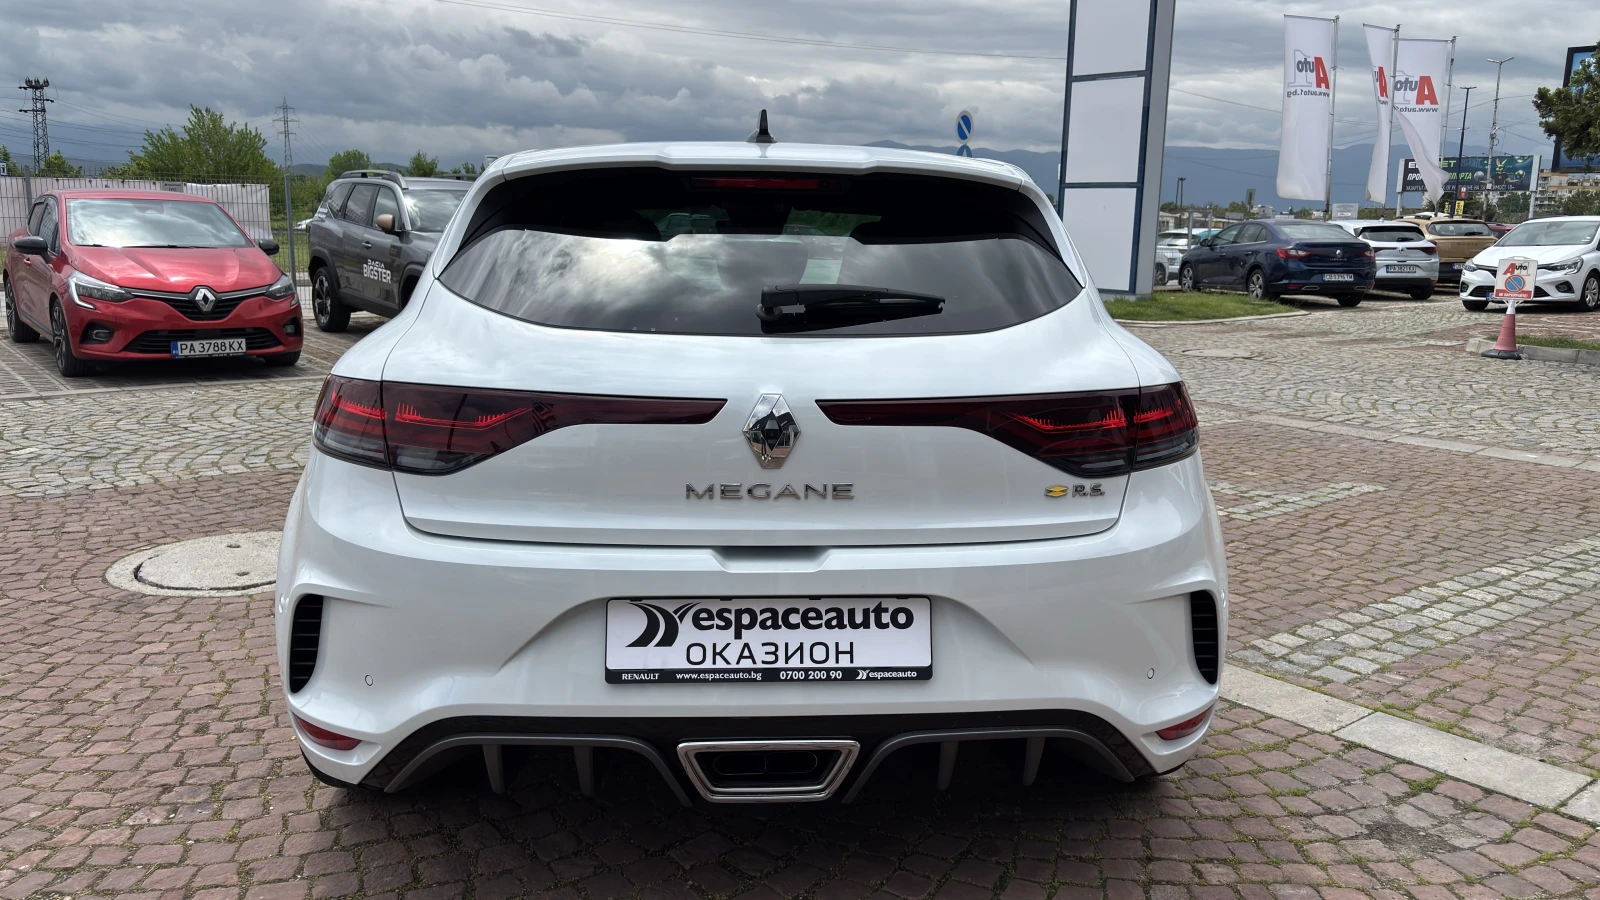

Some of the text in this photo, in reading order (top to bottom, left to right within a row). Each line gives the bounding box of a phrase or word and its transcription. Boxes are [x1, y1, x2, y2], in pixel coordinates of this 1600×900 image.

[363, 263, 392, 284] BIGSTER
[198, 342, 227, 353] 3788
[685, 482, 855, 500] MEGANE
[691, 601, 915, 640] espaceauto
[686, 642, 854, 665] ОКАЗИОН
[675, 671, 763, 681] www.espaceauto.bg
[779, 671, 805, 680] 0700
[807, 671, 827, 680] 200
[829, 671, 843, 680] 90
[868, 670, 918, 680] espaceauto
